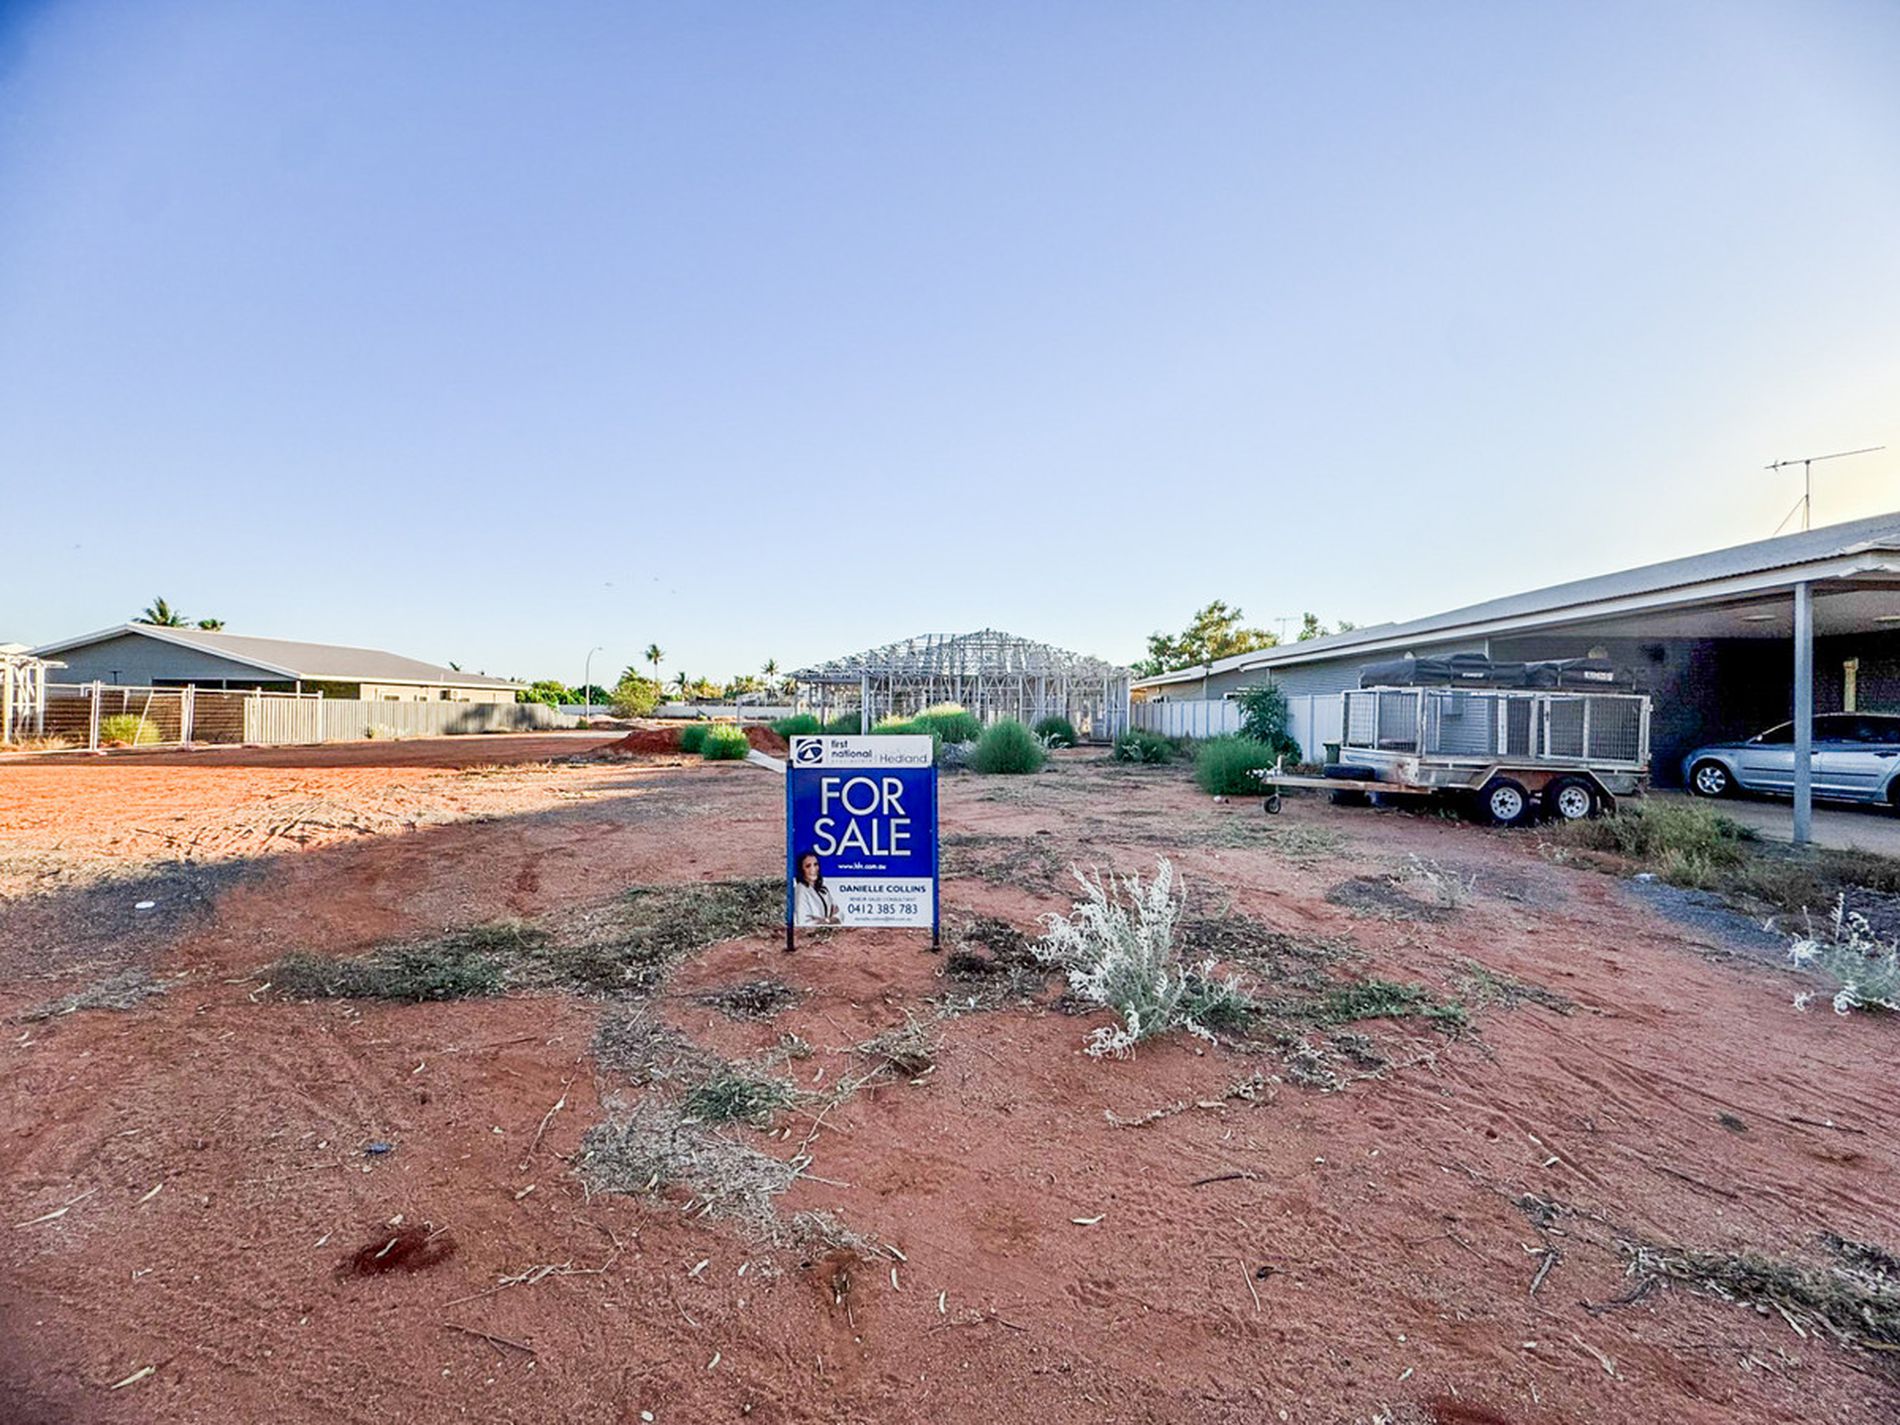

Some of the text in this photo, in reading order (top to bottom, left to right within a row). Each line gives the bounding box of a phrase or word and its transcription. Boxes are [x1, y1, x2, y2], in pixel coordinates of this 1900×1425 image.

[831, 740, 848, 749] first
[831, 750, 872, 758] national
[880, 754, 927, 763] Hedland
[821, 777, 906, 816] FOR
[813, 817, 911, 856] SALE
[840, 885, 926, 893] DANIELLE COLLINS
[848, 904, 918, 914] 0412 385 783
